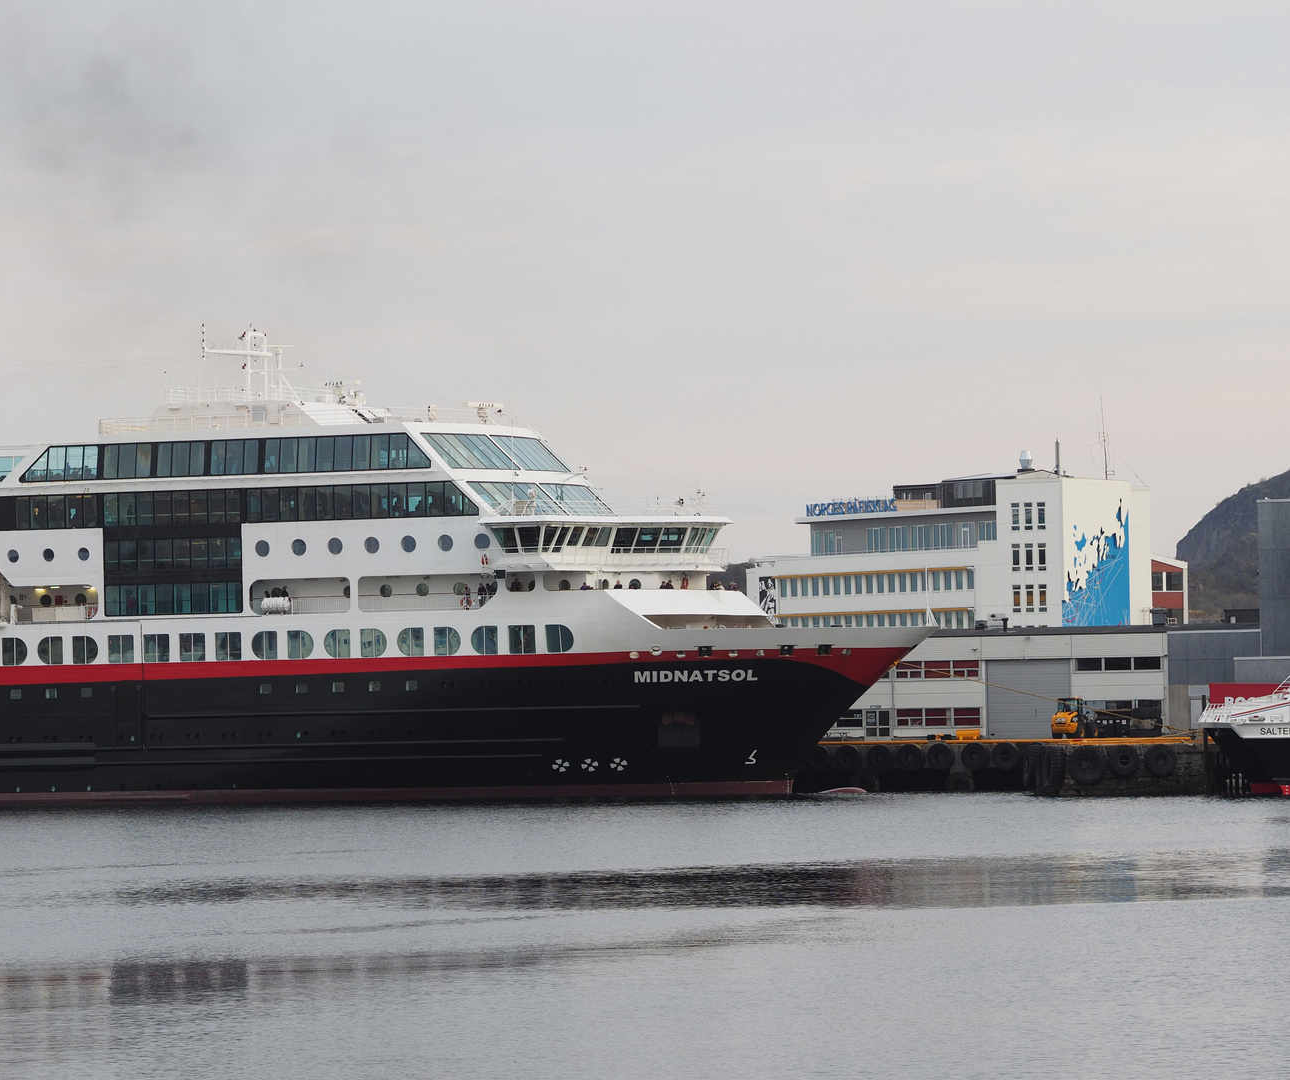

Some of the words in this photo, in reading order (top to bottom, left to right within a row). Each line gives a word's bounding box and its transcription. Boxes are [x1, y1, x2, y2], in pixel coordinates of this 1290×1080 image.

[805, 501, 845, 517] NORGES
[846, 498, 898, 514] RÅFISKLAG
[633, 669, 758, 683] MIDNATSOL
[1259, 727, 1290, 735] SALTE
